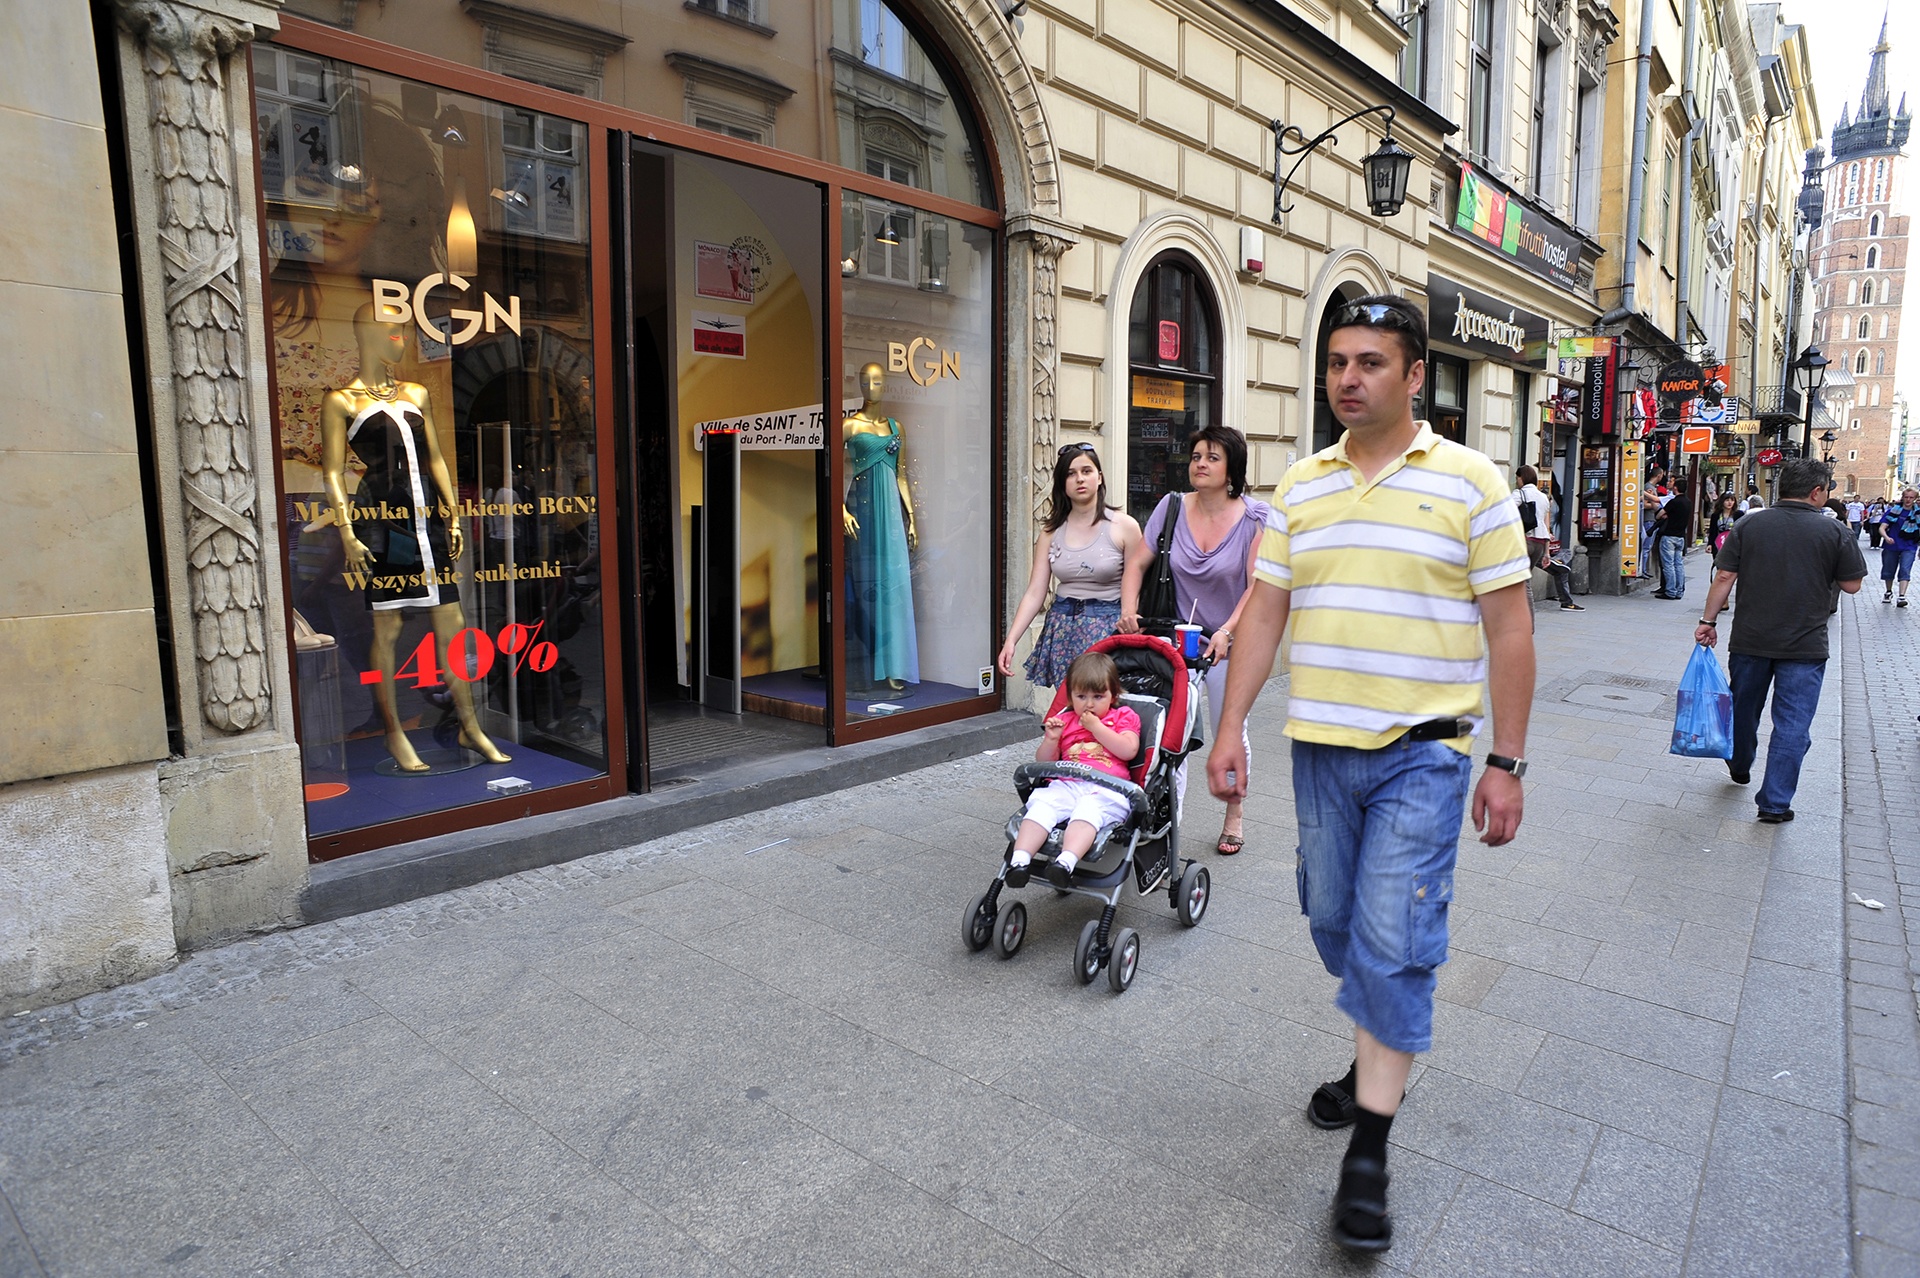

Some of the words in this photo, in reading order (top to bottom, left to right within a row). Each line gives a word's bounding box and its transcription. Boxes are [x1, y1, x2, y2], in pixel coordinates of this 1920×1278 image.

[371, 272, 521, 346] BGN
[1452, 292, 1525, 353] Accessorize
[888, 336, 961, 387] BGN
[1667, 367, 1696, 377] GOLD
[1661, 379, 1699, 392] KANTOR
[733, 419, 750, 431] de
[754, 414, 797, 431] SAINT
[1725, 398, 1737, 424] CLUB
[740, 434, 753, 444] du
[755, 433, 776, 445] Port
[784, 433, 806, 445] Plan
[808, 433, 820, 445] de
[294, 500, 410, 524] Majówka
[415, 503, 433, 519] w
[439, 497, 534, 518] sukience
[539, 495, 597, 515] BGN!
[1624, 468, 1637, 548] HOSTEL
[342, 564, 464, 593] Wszystkie
[473, 560, 562, 583] sukienki
[359, 619, 559, 690] -40%
